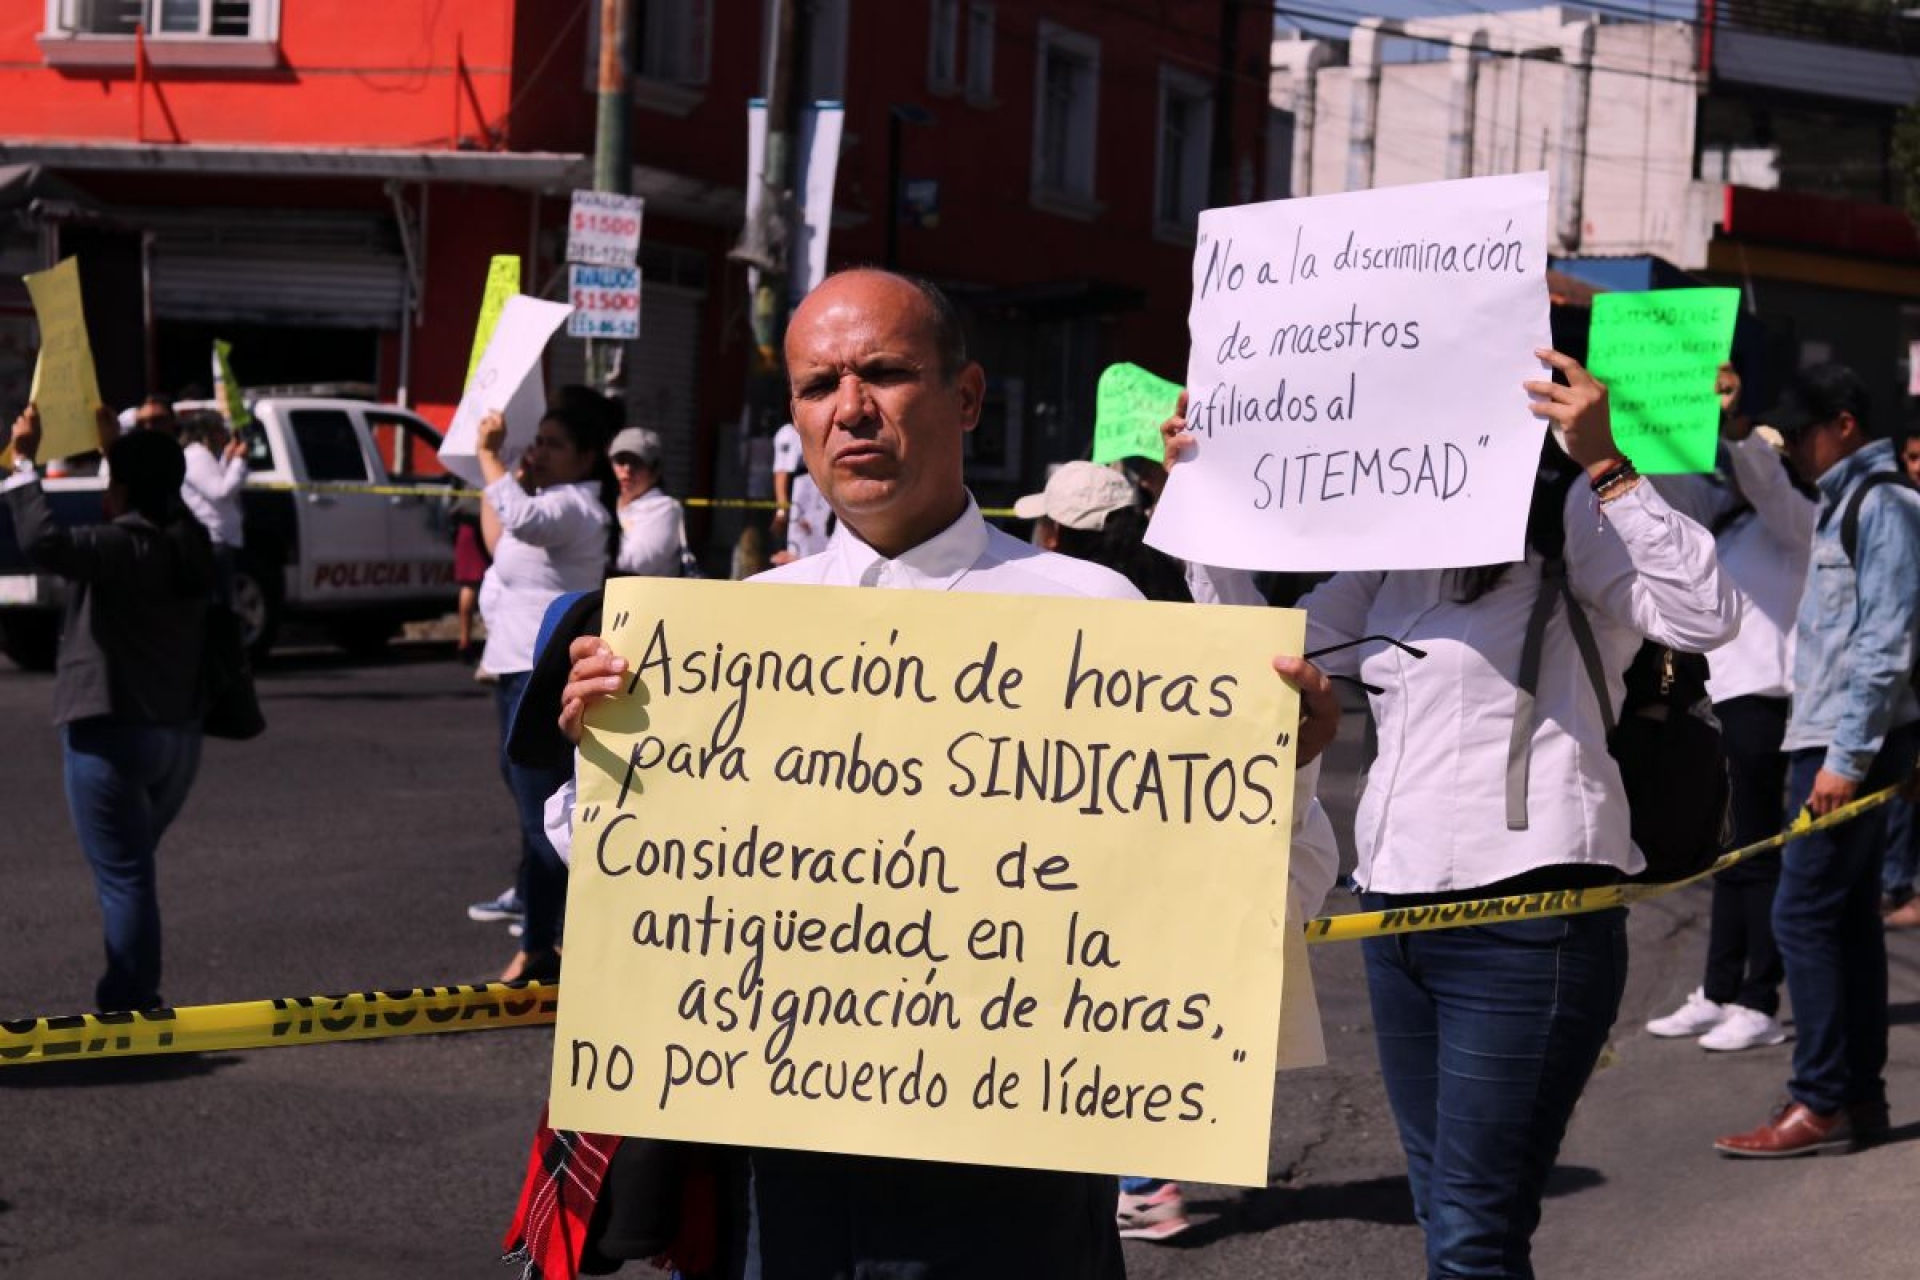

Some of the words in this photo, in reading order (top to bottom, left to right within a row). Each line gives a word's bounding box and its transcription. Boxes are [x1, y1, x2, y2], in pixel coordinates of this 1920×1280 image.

[575, 212, 636, 236] $1500
[1257, 262, 1278, 284] a
[1290, 224, 1319, 285] la
[1333, 219, 1526, 273] discriminación
[574, 290, 639, 312] $1500
[1217, 320, 1257, 364] de
[1269, 303, 1420, 357] maestros
[1186, 381, 1318, 439] afiliados
[1327, 372, 1356, 421] al
[314, 561, 411, 588] POLICIA
[420, 561, 456, 585] VIA
[954, 641, 1024, 710] de
[1064, 628, 1238, 717] horas
[616, 736, 750, 809] para
[774, 732, 923, 796] ambos
[996, 841, 1078, 891] de
[632, 895, 950, 1000] antigüedad
[967, 918, 1025, 963] en
[1066, 911, 1121, 968] la
[677, 968, 961, 1065] asignación
[980, 976, 1038, 1031] de
[1063, 977, 1224, 1040] horas,
[571, 1039, 634, 1092] no
[658, 1043, 749, 1110] por
[769, 1048, 948, 1108] acuerdo
[972, 1056, 1020, 1109] de
